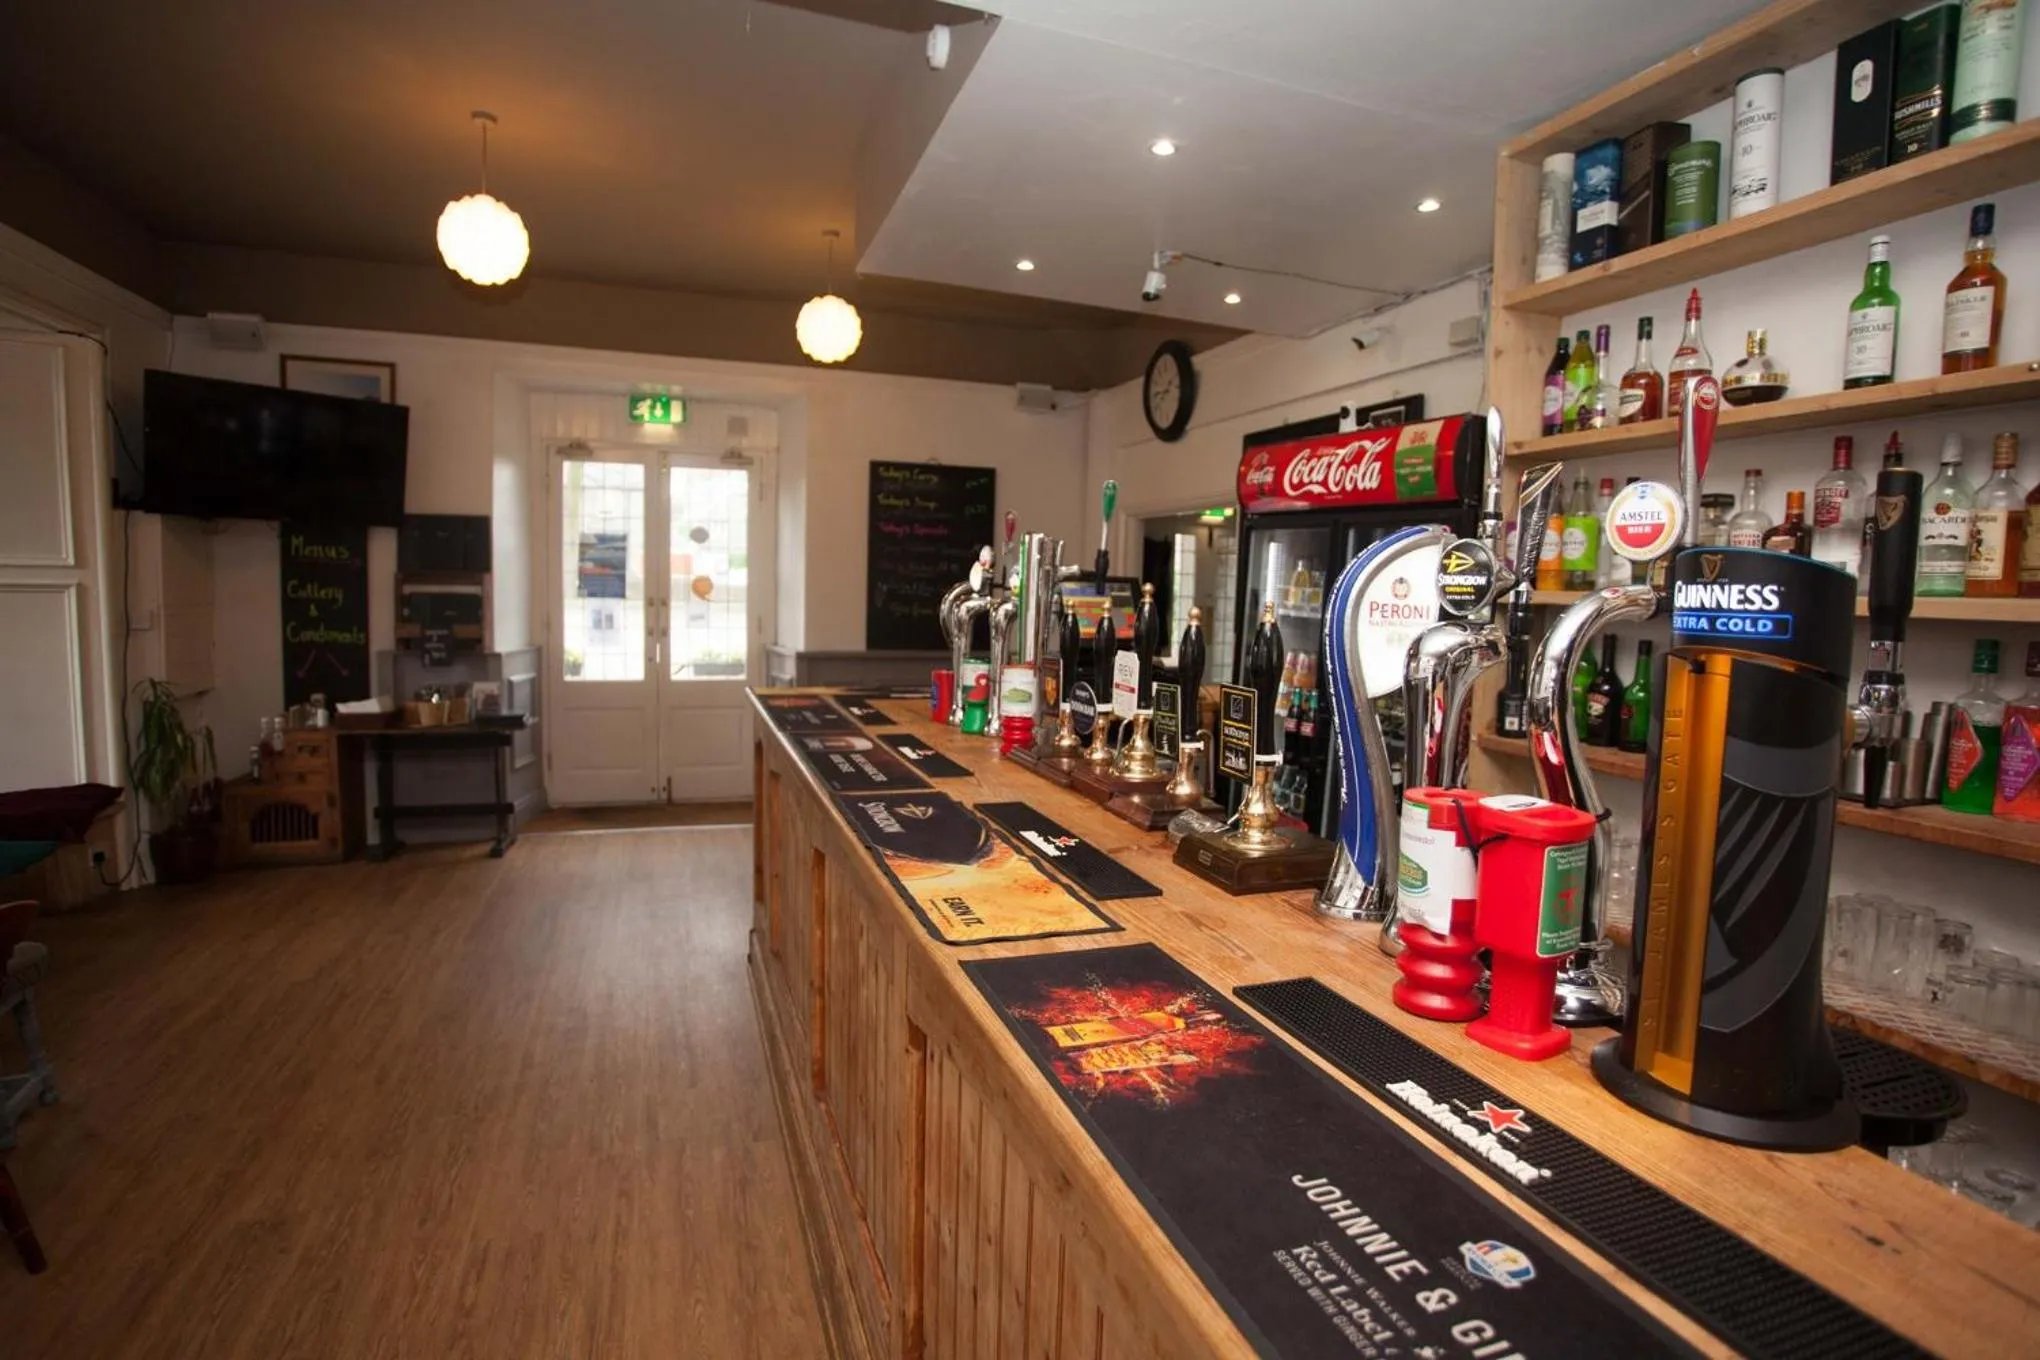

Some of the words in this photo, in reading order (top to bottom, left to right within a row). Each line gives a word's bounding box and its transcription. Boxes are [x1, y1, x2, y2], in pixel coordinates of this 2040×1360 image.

[1284, 437, 1393, 497] Coca-Cola
[1620, 510, 1664, 522] AMSTEL
[291, 534, 350, 559] Menus
[287, 580, 344, 609] Cutlery
[1437, 573, 1488, 586] STRONGBOW
[1369, 601, 1430, 620] PERONI
[1674, 580, 1780, 611] GUINNESS
[1715, 618, 1773, 632] COLD
[1386, 1080, 1545, 1185] Heineken
[1291, 1173, 1430, 1283] JOHNNIE
[1414, 1287, 1459, 1314] &
[1272, 1249, 1312, 1286] SERVED
[1306, 1286, 1339, 1316] WITH
[1331, 1315, 1378, 1358] GINGER
[1291, 1245, 1338, 1285] Red
[1328, 1284, 1396, 1342] Label
